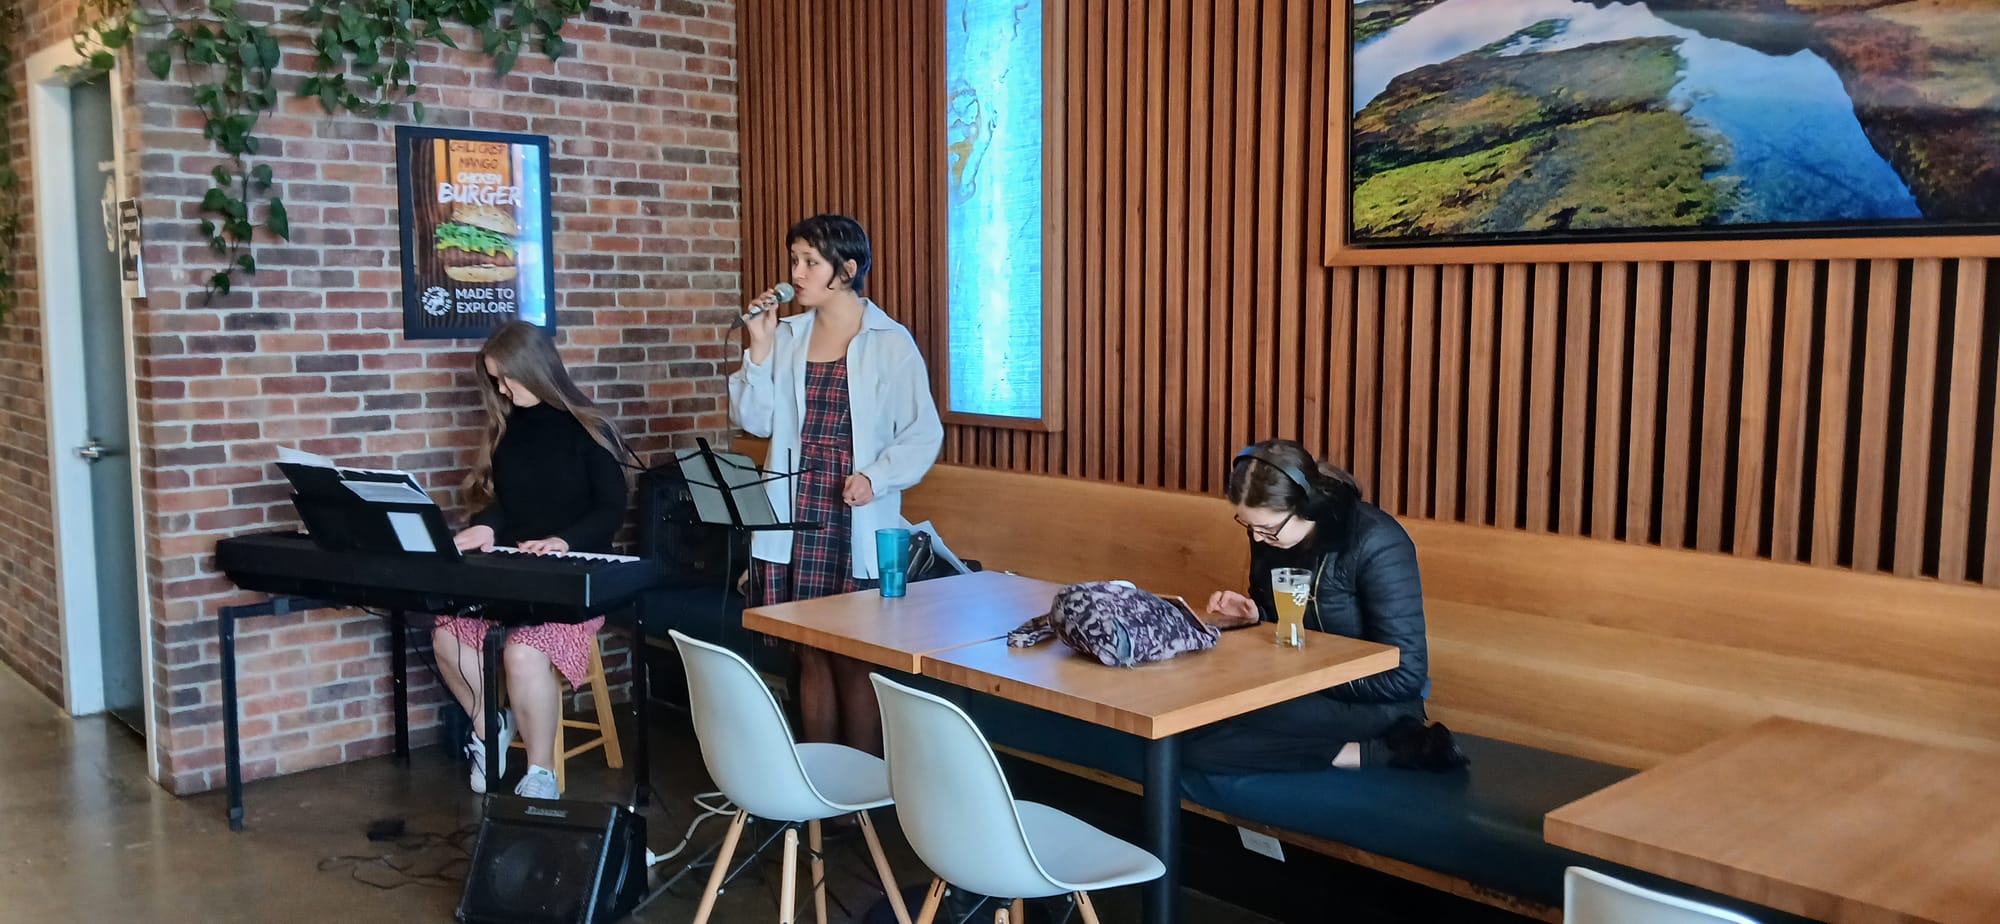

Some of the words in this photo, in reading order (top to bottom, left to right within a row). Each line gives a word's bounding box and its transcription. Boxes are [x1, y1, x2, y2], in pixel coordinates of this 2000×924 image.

[460, 158, 498, 169] MANGO
[457, 173, 502, 184] CHICKEN
[438, 182, 522, 206] BURGER
[455, 288, 493, 299] MADE
[495, 288, 514, 299] TO
[457, 302, 515, 312] EXPLORE
